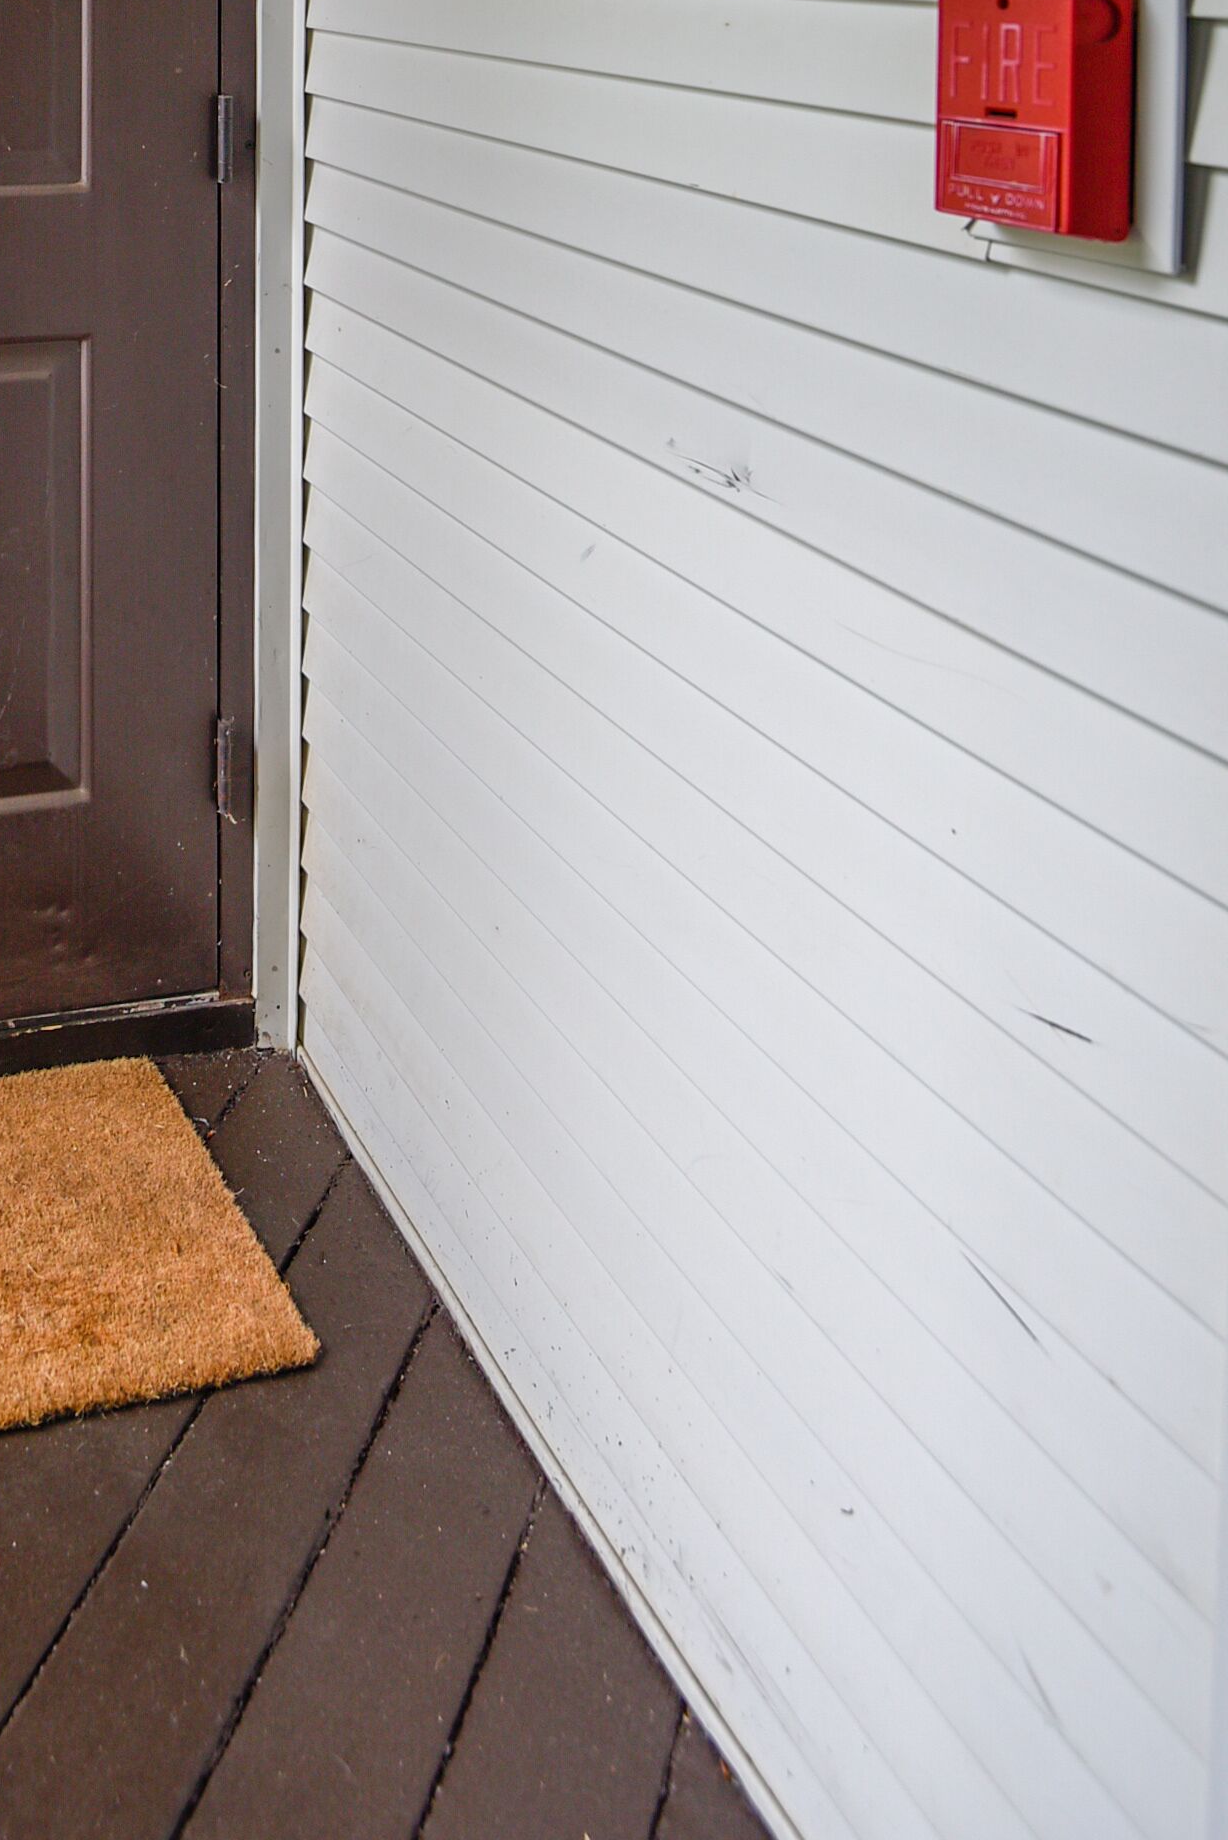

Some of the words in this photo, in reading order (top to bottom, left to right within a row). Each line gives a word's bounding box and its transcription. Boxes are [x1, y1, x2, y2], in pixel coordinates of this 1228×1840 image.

[949, 22, 1056, 107] FIRE
[947, 182, 984, 201] PULL
[1005, 192, 1045, 210] DOWN
